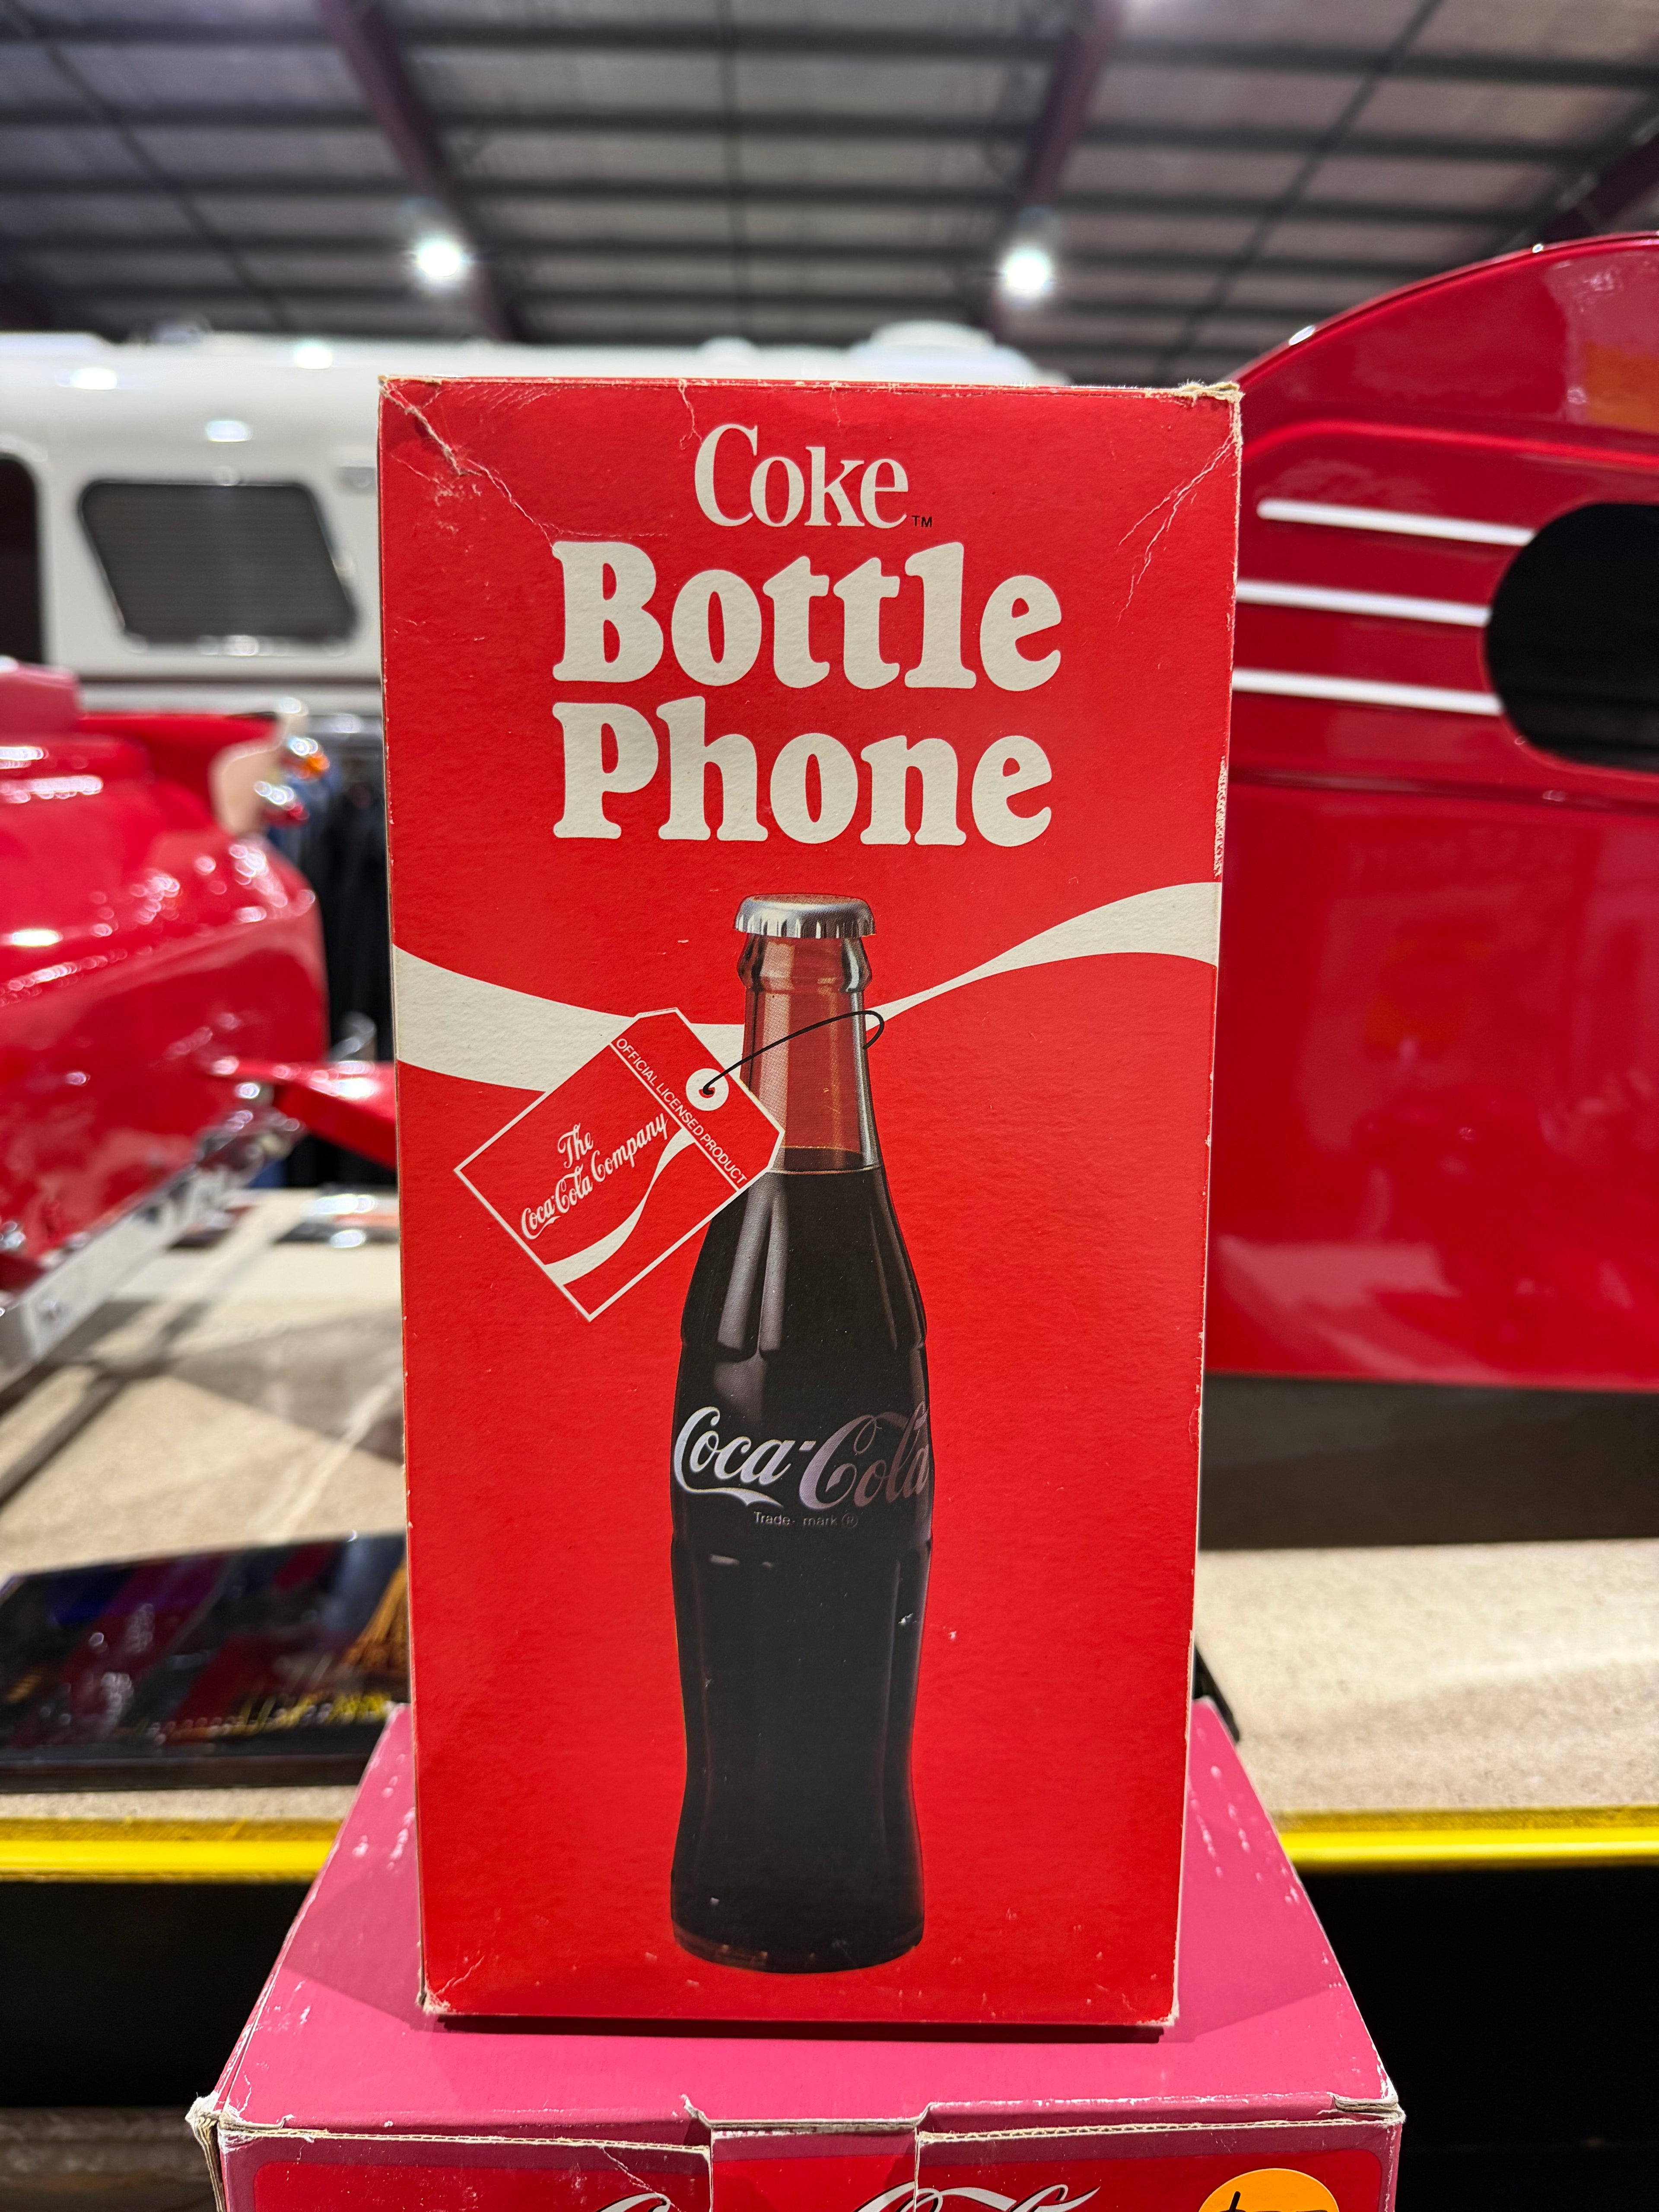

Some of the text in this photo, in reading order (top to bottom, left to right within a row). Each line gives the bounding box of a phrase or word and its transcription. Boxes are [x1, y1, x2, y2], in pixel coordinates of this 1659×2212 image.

[694, 423, 933, 529] Coke TM
[550, 540, 1062, 692] Bottle
[552, 696, 1052, 847] Phone
[557, 1122, 594, 1169] The
[616, 1038, 747, 1184] OFFICIAL LICENSED PRODUCT
[521, 1112, 668, 1240] Coca-Cola Company
[674, 1401, 931, 1510] Coca-Cola
[802, 1515, 838, 1526] mark
